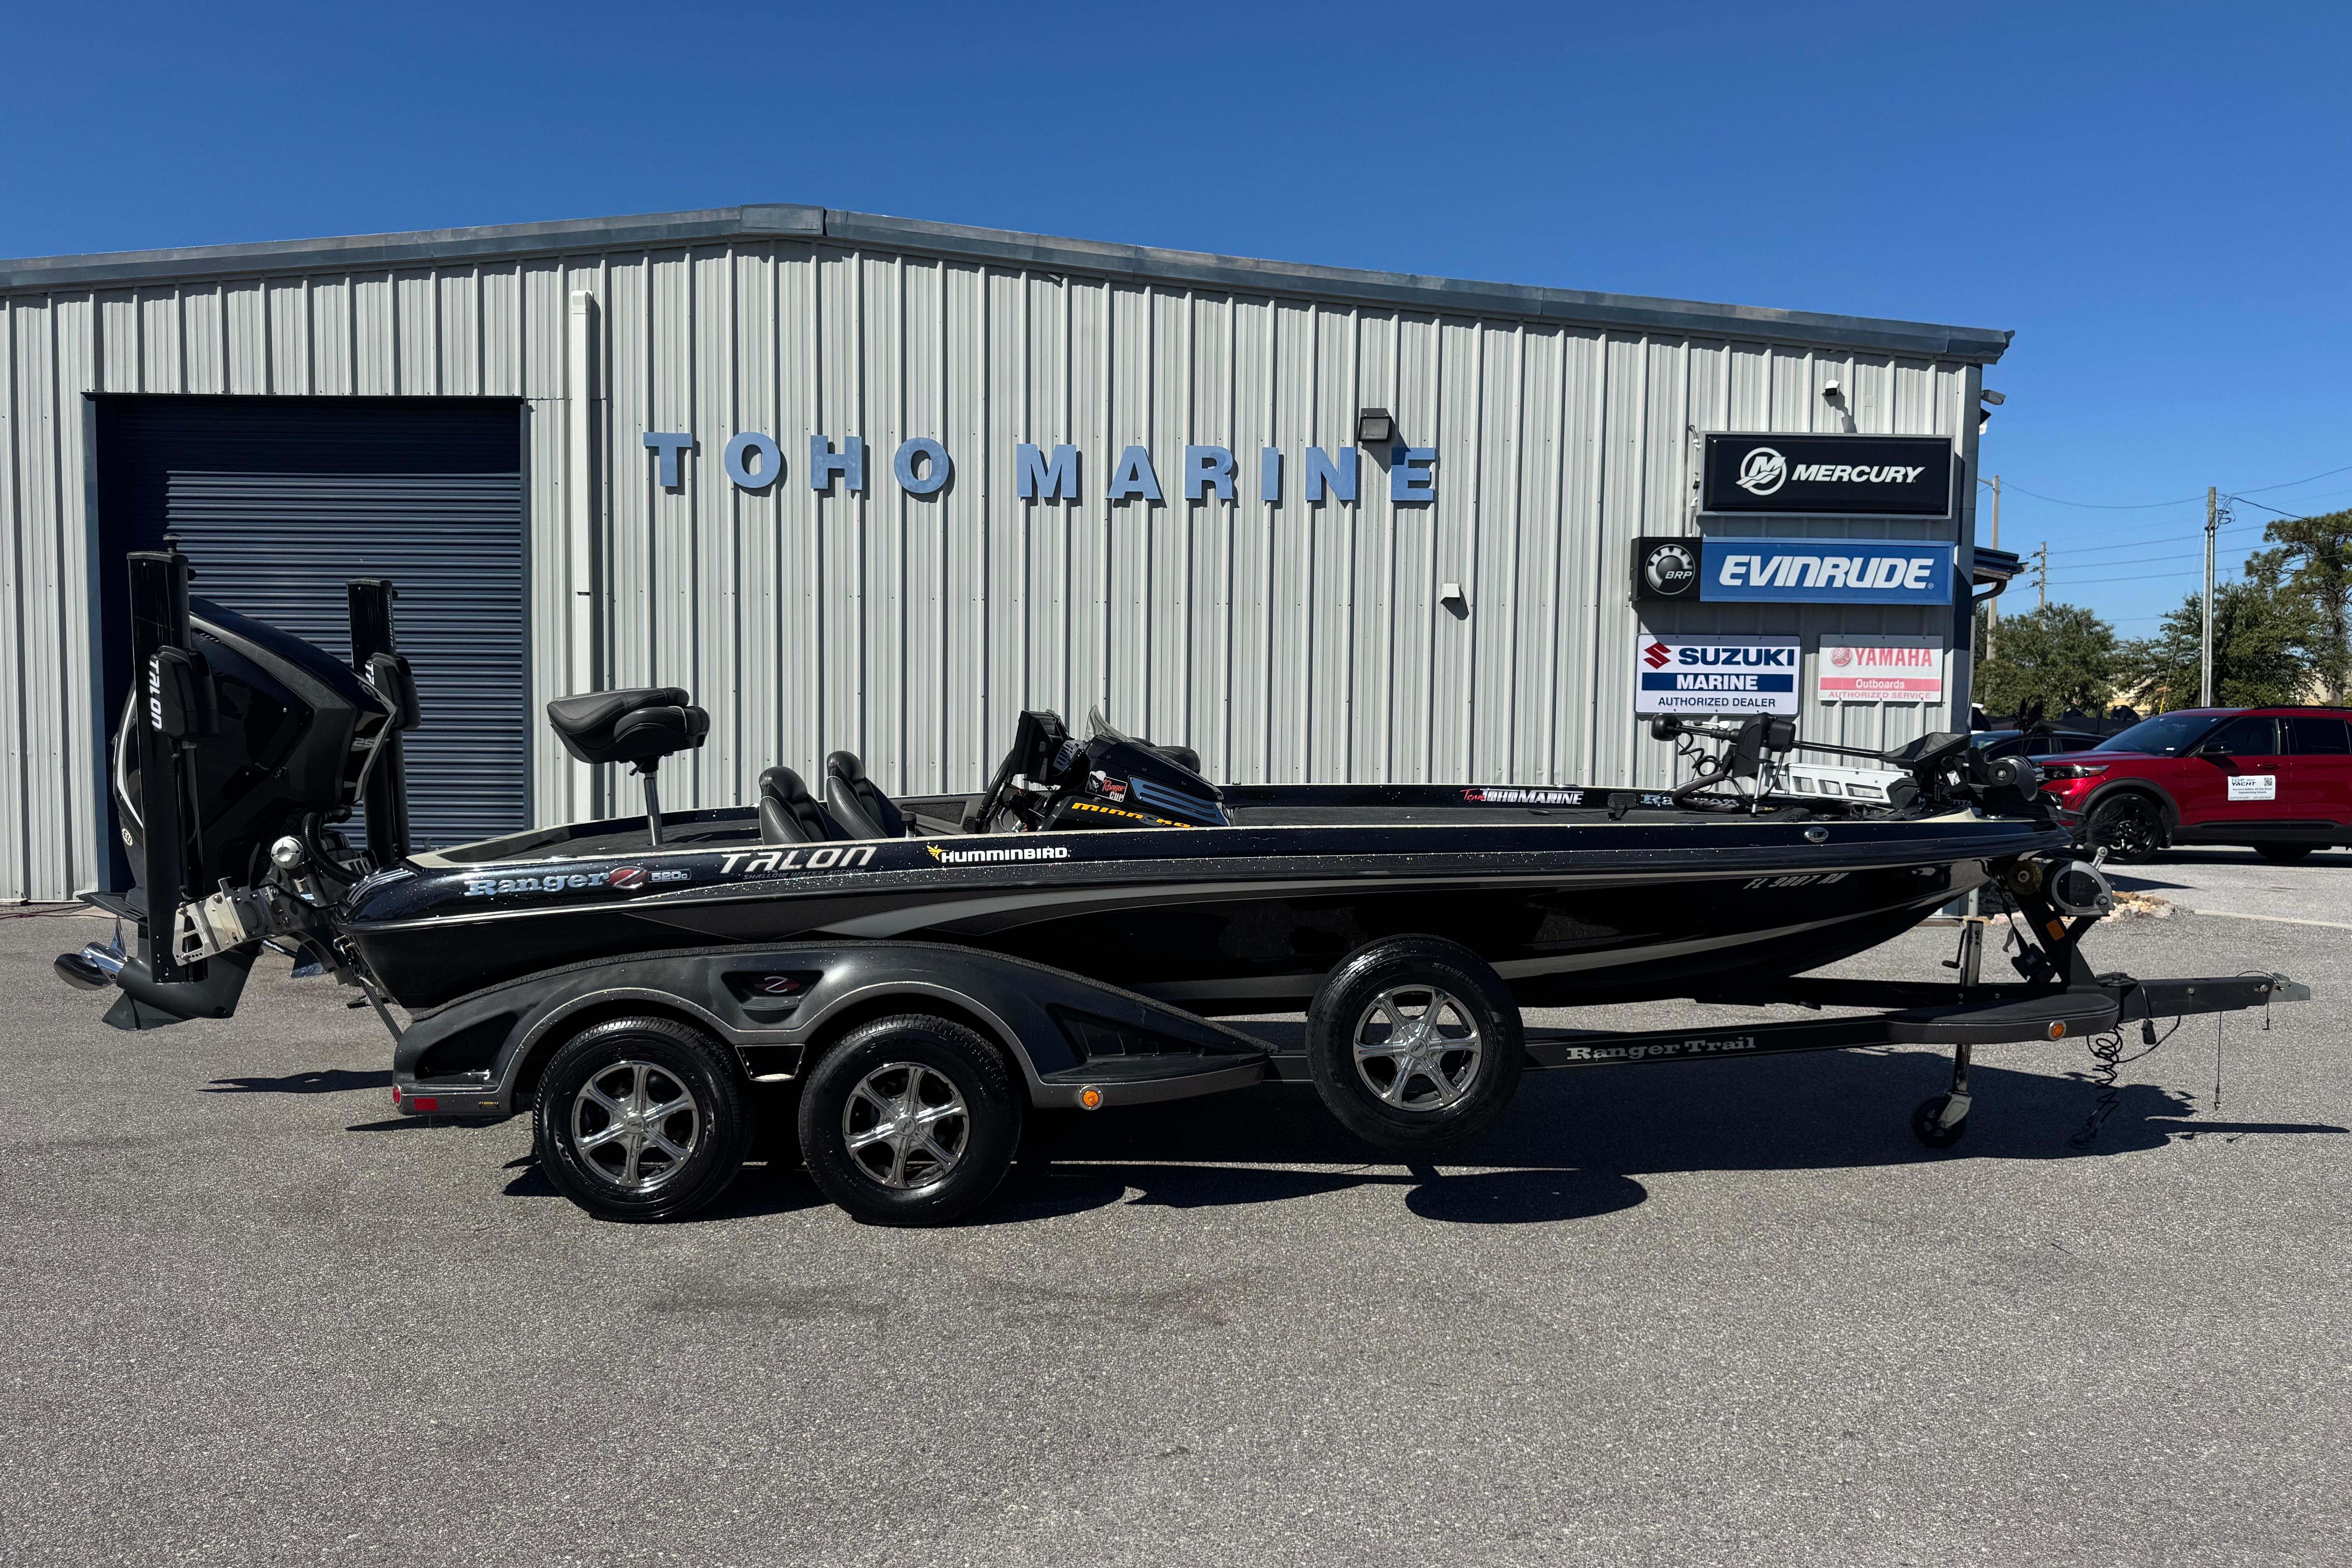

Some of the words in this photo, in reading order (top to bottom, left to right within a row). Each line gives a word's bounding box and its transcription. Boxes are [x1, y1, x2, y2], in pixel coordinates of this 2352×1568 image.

[643, 432, 950, 494] TOHO
[1016, 443, 1435, 501] MARINE
[1791, 464, 1926, 483] MERCURY
[1665, 571, 1693, 579] BRP
[1719, 555, 1934, 589] EVINRUDE
[1678, 648, 1794, 666] SUZUKI
[1855, 647, 1932, 667] YAMAHA
[1677, 674, 1758, 690] MARINE
[1856, 679, 1904, 688] Outboards
[149, 660, 162, 729] TALON
[1658, 697, 1729, 706] AUTHORIZED
[1733, 698, 1776, 707] DEALER
[353, 737, 374, 748] 25
[1109, 791, 1124, 802] CUP
[720, 846, 877, 874] TALON
[941, 847, 1068, 863] HUMMINBIRD
[464, 872, 610, 897] Ranger
[1743, 878, 1769, 889] FL
[1566, 1043, 1680, 1060] Ranger
[1684, 1036, 1756, 1053] Trail
